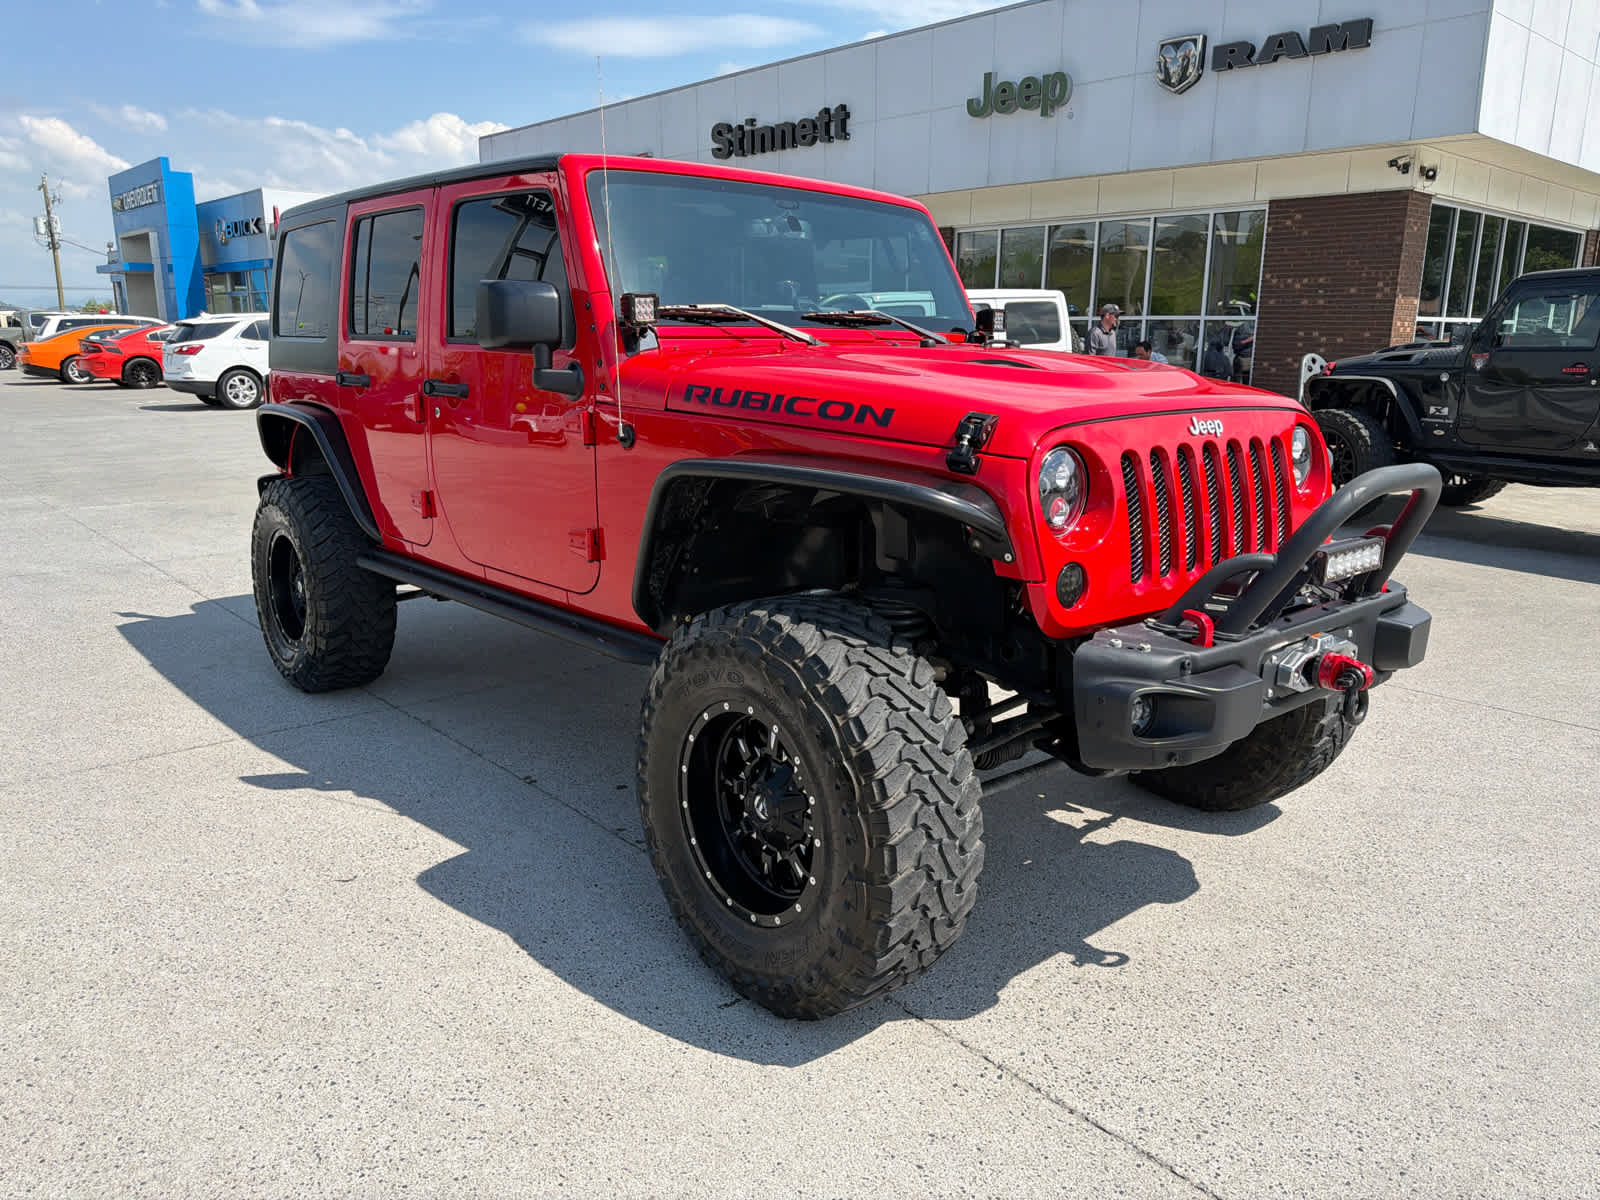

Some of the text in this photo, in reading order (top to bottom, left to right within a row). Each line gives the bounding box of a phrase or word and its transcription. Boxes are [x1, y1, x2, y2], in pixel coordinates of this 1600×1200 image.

[1211, 17, 1374, 72] RAM
[966, 71, 1072, 118] Jeep
[711, 103, 851, 160] Stinnett
[123, 183, 159, 210] CHEVROLET
[225, 217, 263, 239] BUICK
[683, 383, 896, 428] RUBICON
[1188, 416, 1224, 438] Jeep
